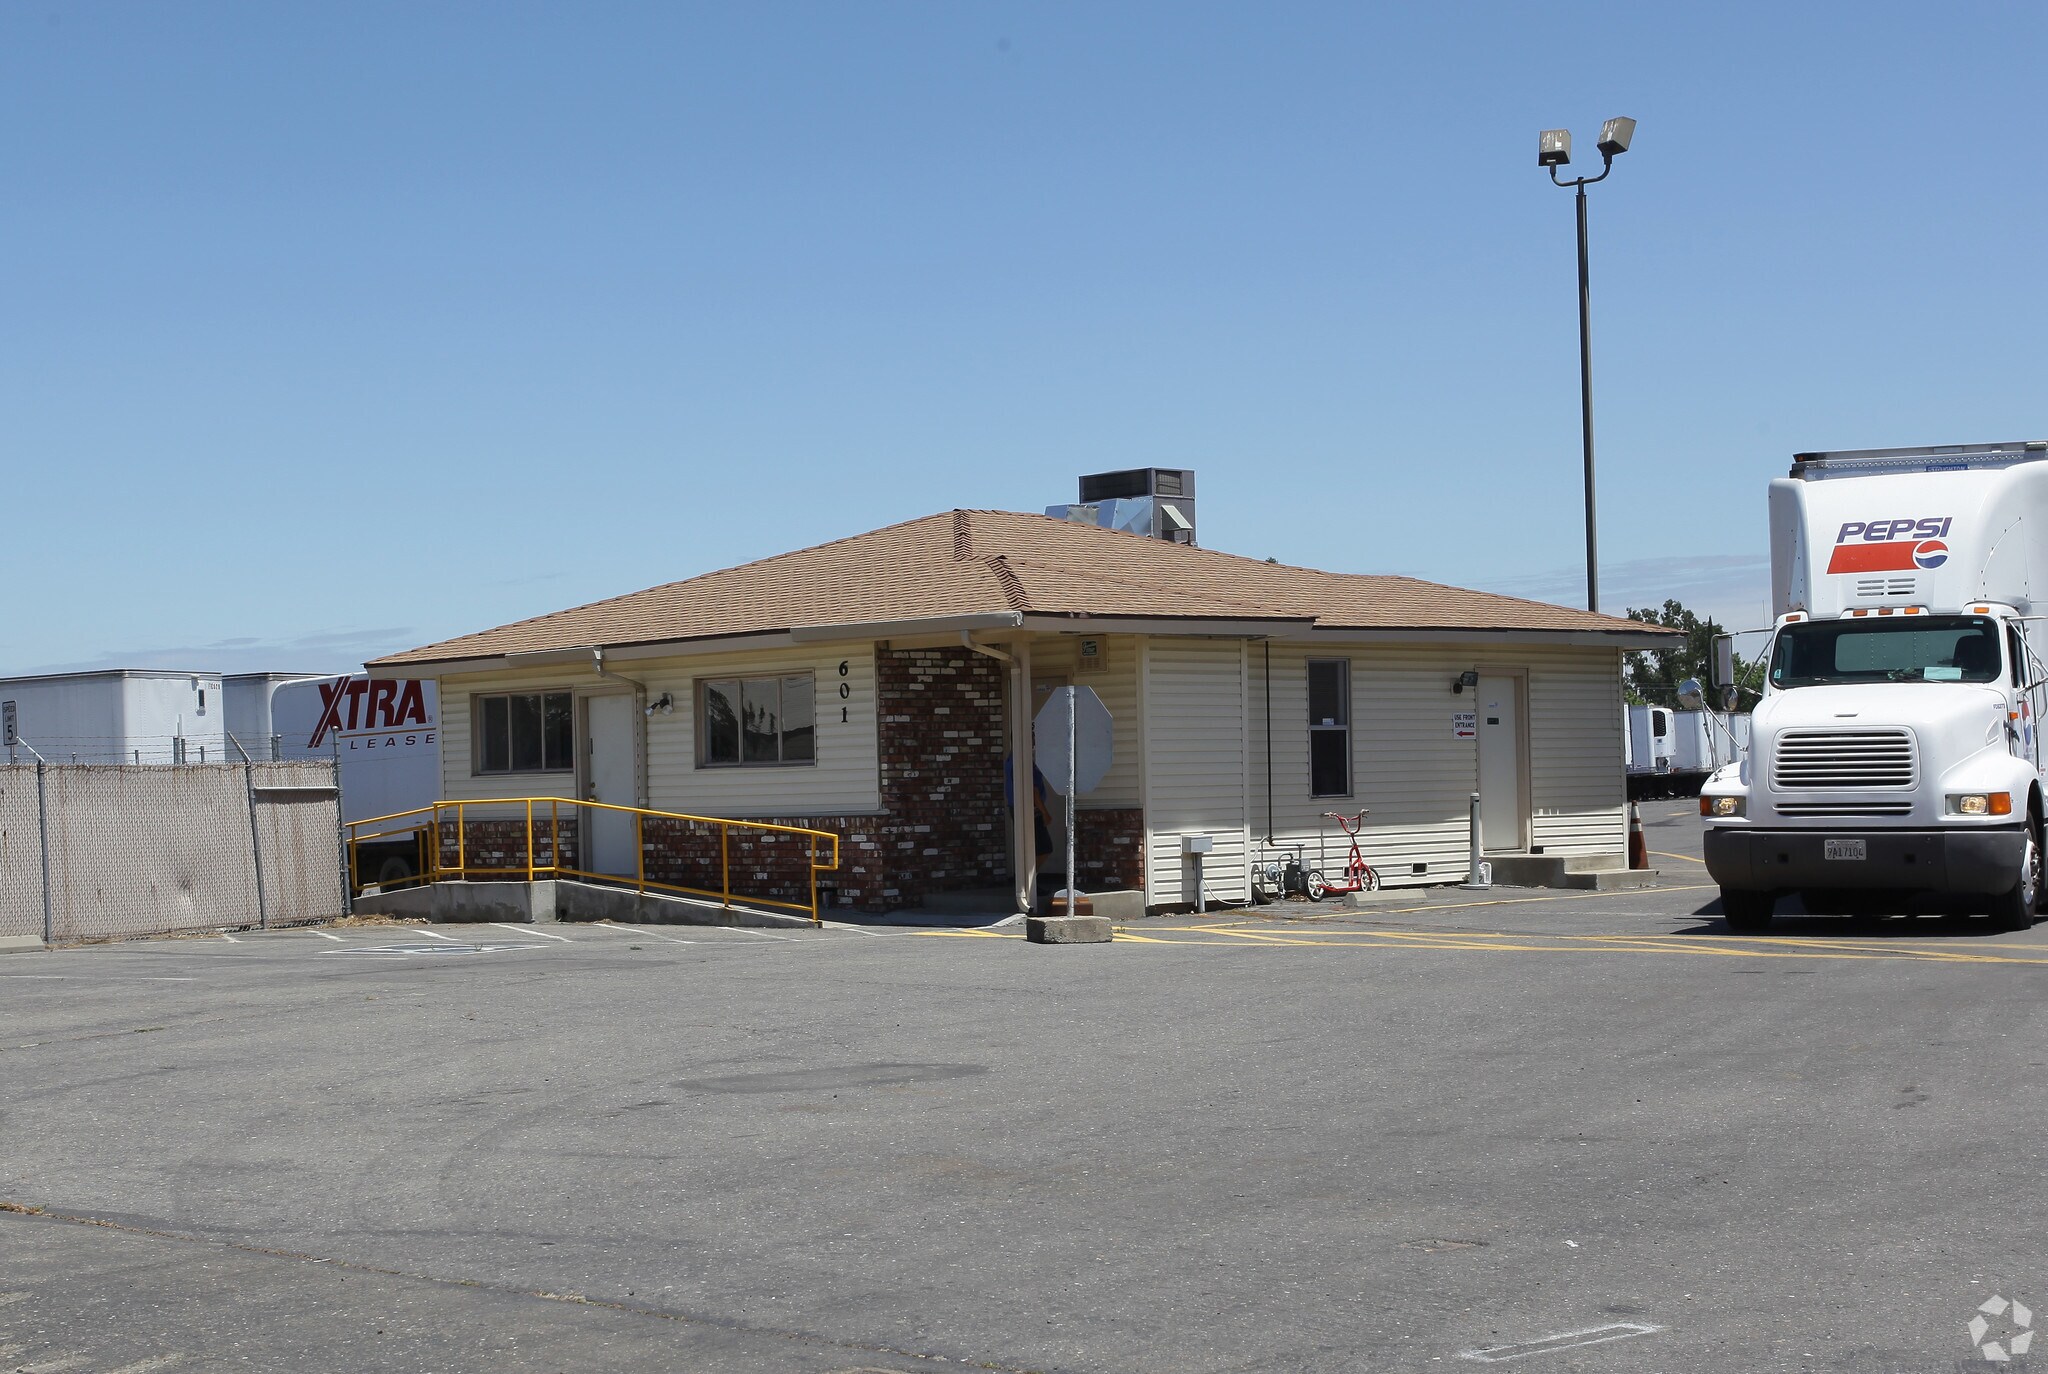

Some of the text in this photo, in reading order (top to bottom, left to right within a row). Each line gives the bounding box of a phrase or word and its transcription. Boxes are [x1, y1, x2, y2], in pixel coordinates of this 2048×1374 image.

[1836, 517, 1953, 543] PEPSI
[838, 660, 850, 723] 601
[307, 676, 427, 749] XTRA
[7, 724, 14, 740] 5
[350, 733, 436, 750] LEASE
